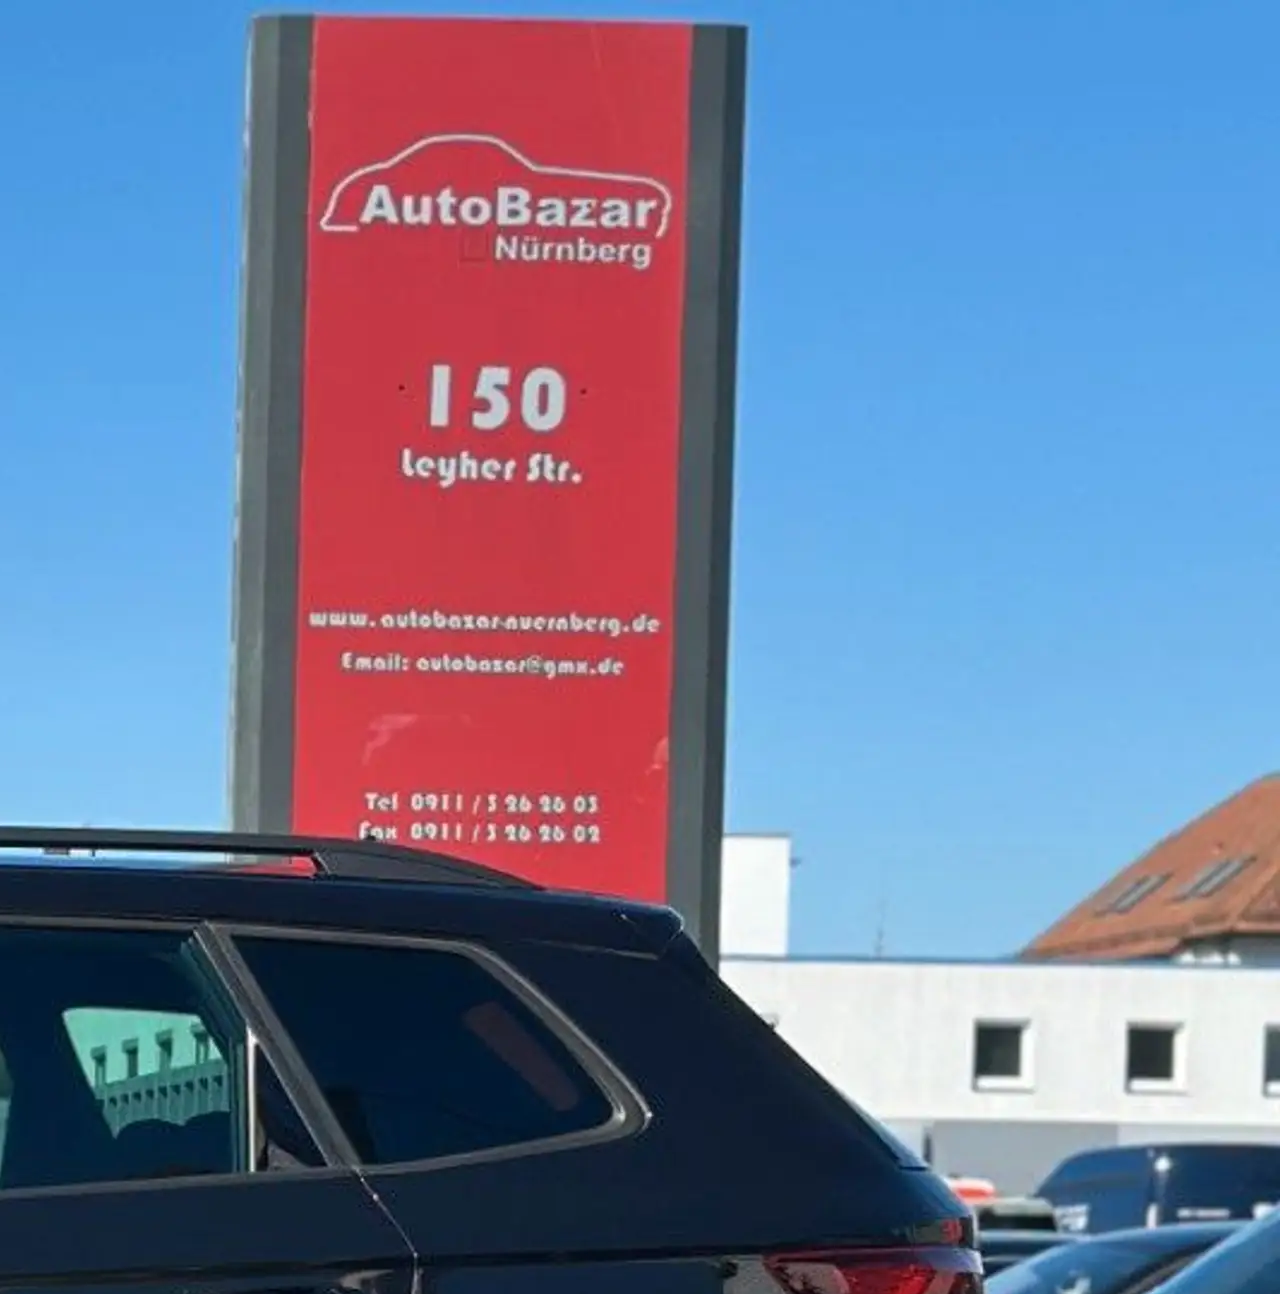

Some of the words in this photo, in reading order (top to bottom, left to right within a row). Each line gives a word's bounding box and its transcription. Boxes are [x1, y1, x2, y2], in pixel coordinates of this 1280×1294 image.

[359, 184, 658, 229] AutoBazar
[494, 234, 651, 269] Nürnberg
[401, 448, 516, 488] Leyher
[527, 453, 582, 484] Str.
[341, 652, 409, 672] Email:
[416, 653, 624, 680] autobazar@gmx.de
[365, 792, 399, 812] Tel
[411, 792, 463, 812] 0911
[358, 820, 398, 841] Fax
[410, 822, 463, 842] 0911
